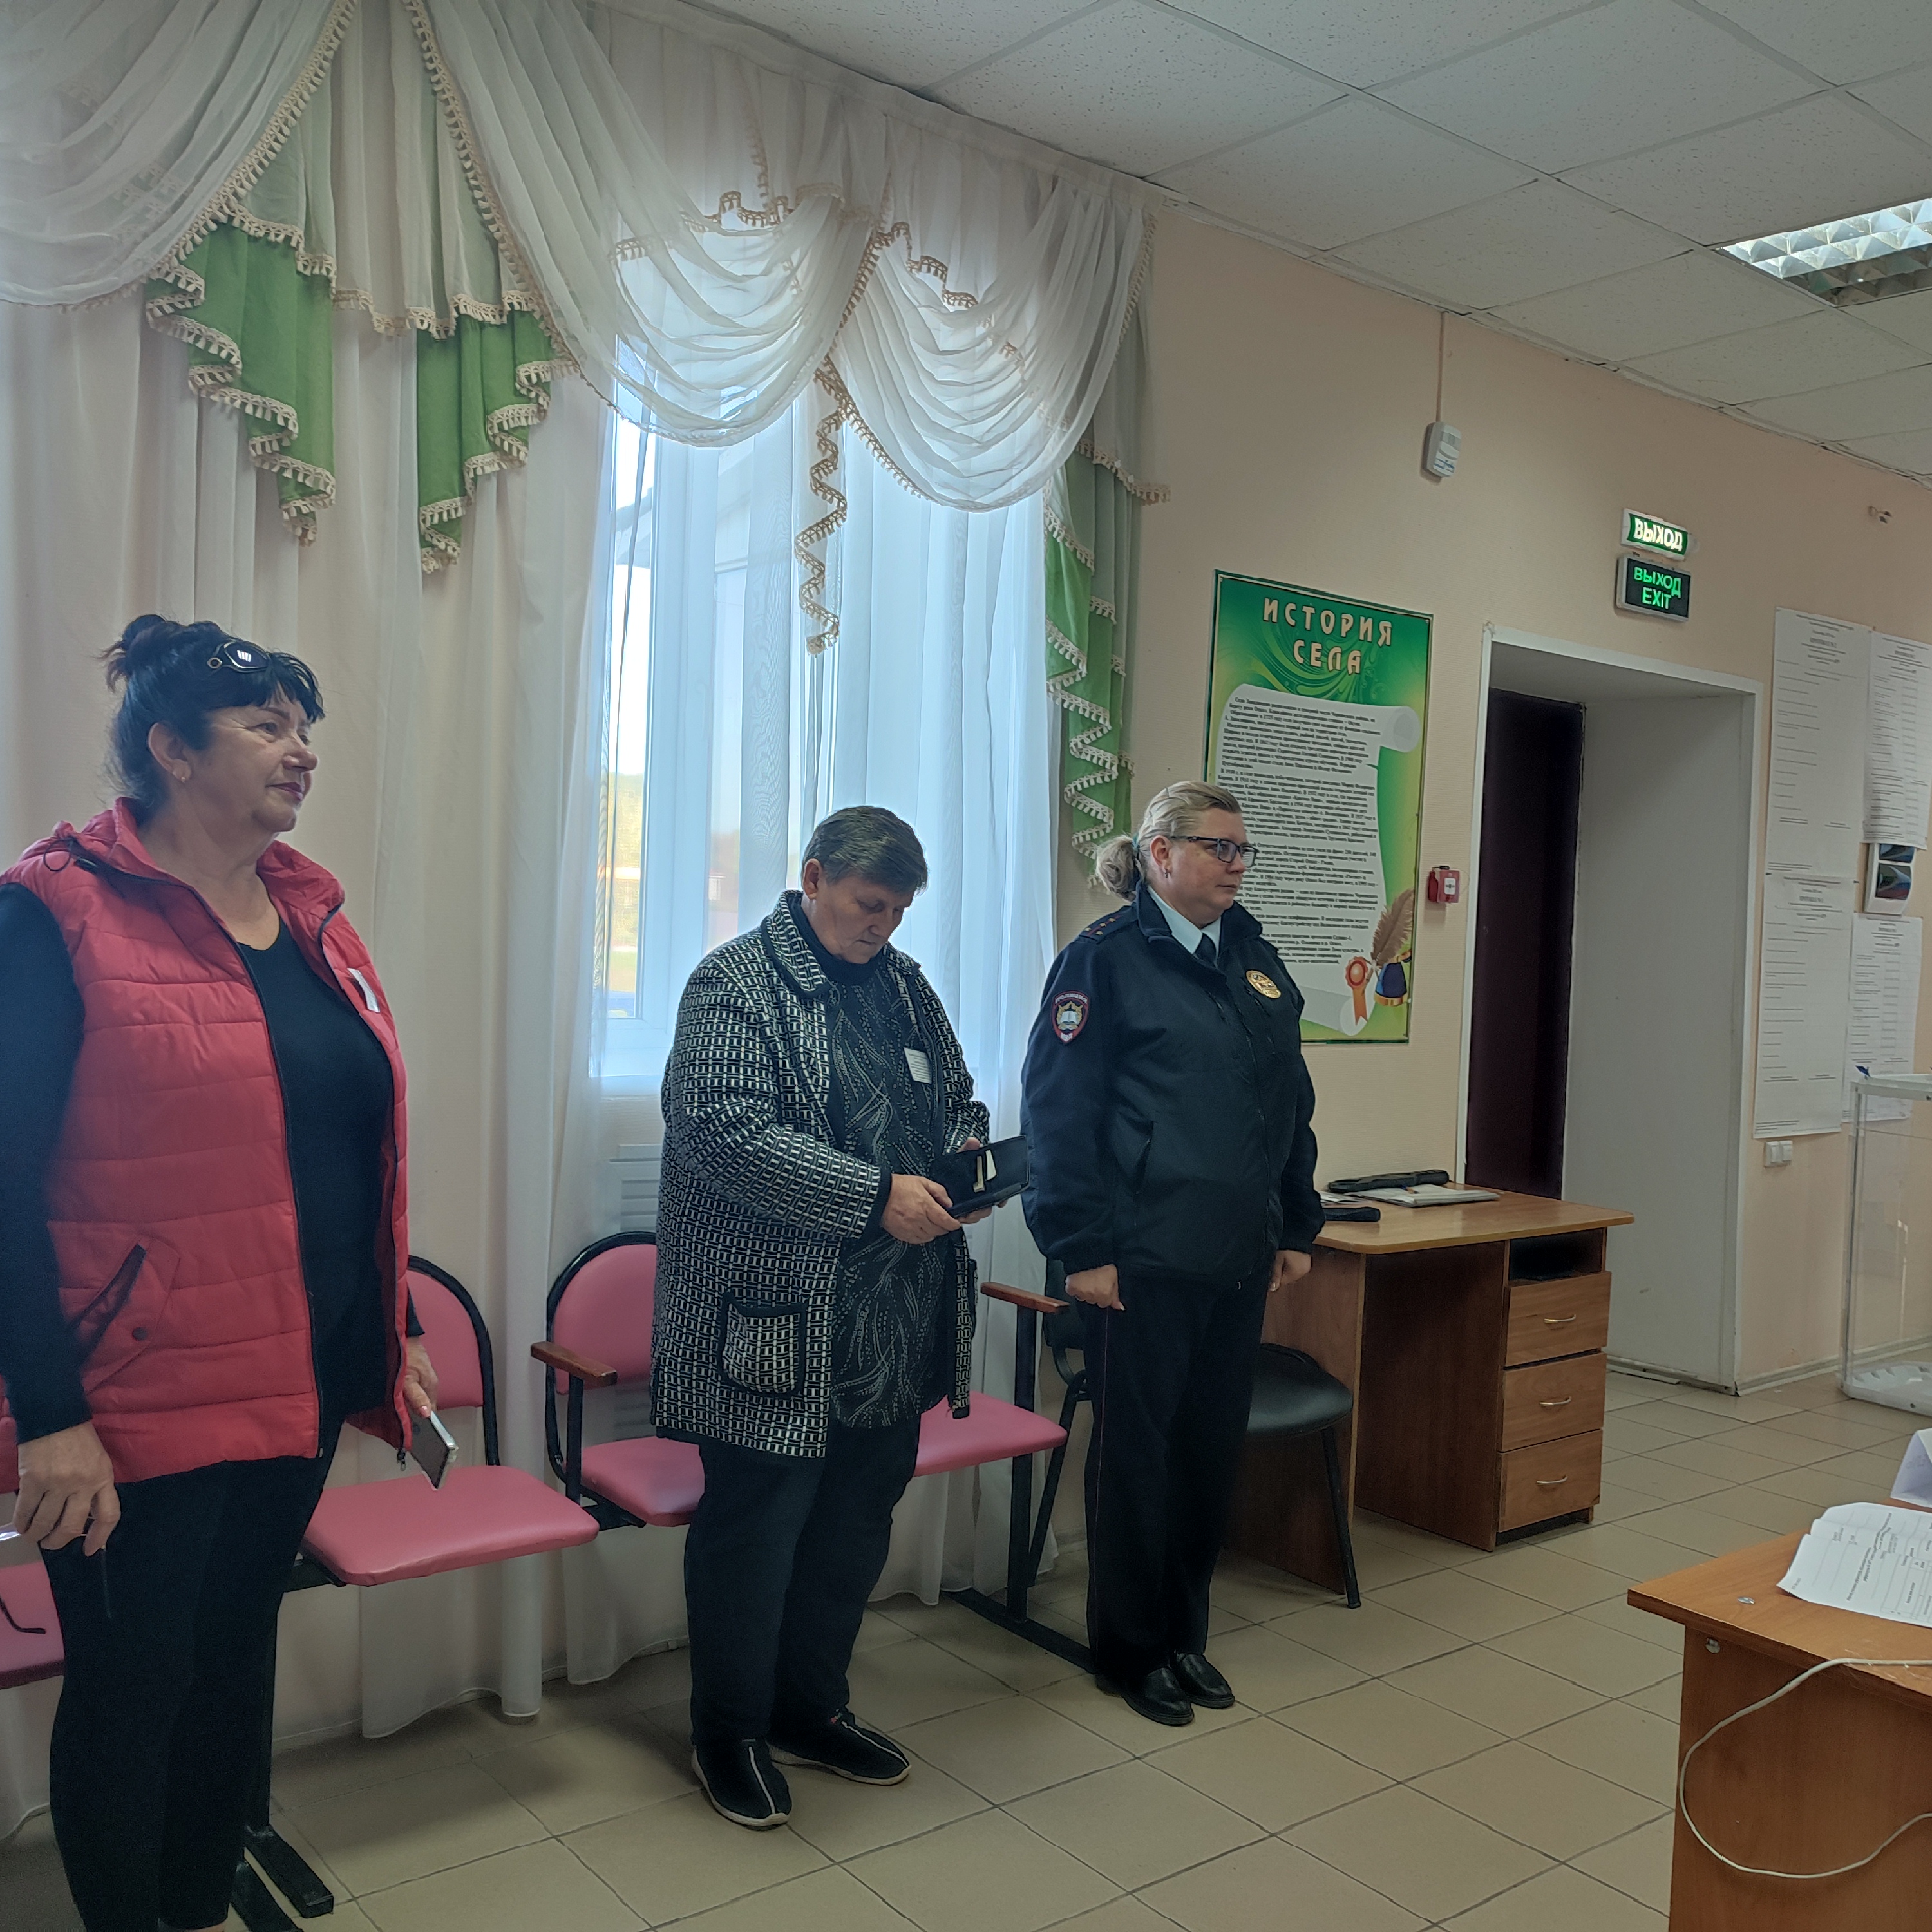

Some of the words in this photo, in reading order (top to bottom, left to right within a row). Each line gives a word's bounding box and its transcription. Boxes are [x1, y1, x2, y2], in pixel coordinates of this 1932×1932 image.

[1634, 518, 1683, 551] ВЫХОД
[1633, 567, 1681, 598] ВЫХОД
[1642, 587, 1672, 609] EXIT
[1263, 597, 1393, 647] ИСТОРИЯ
[1293, 639, 1362, 675] СЕЛА
